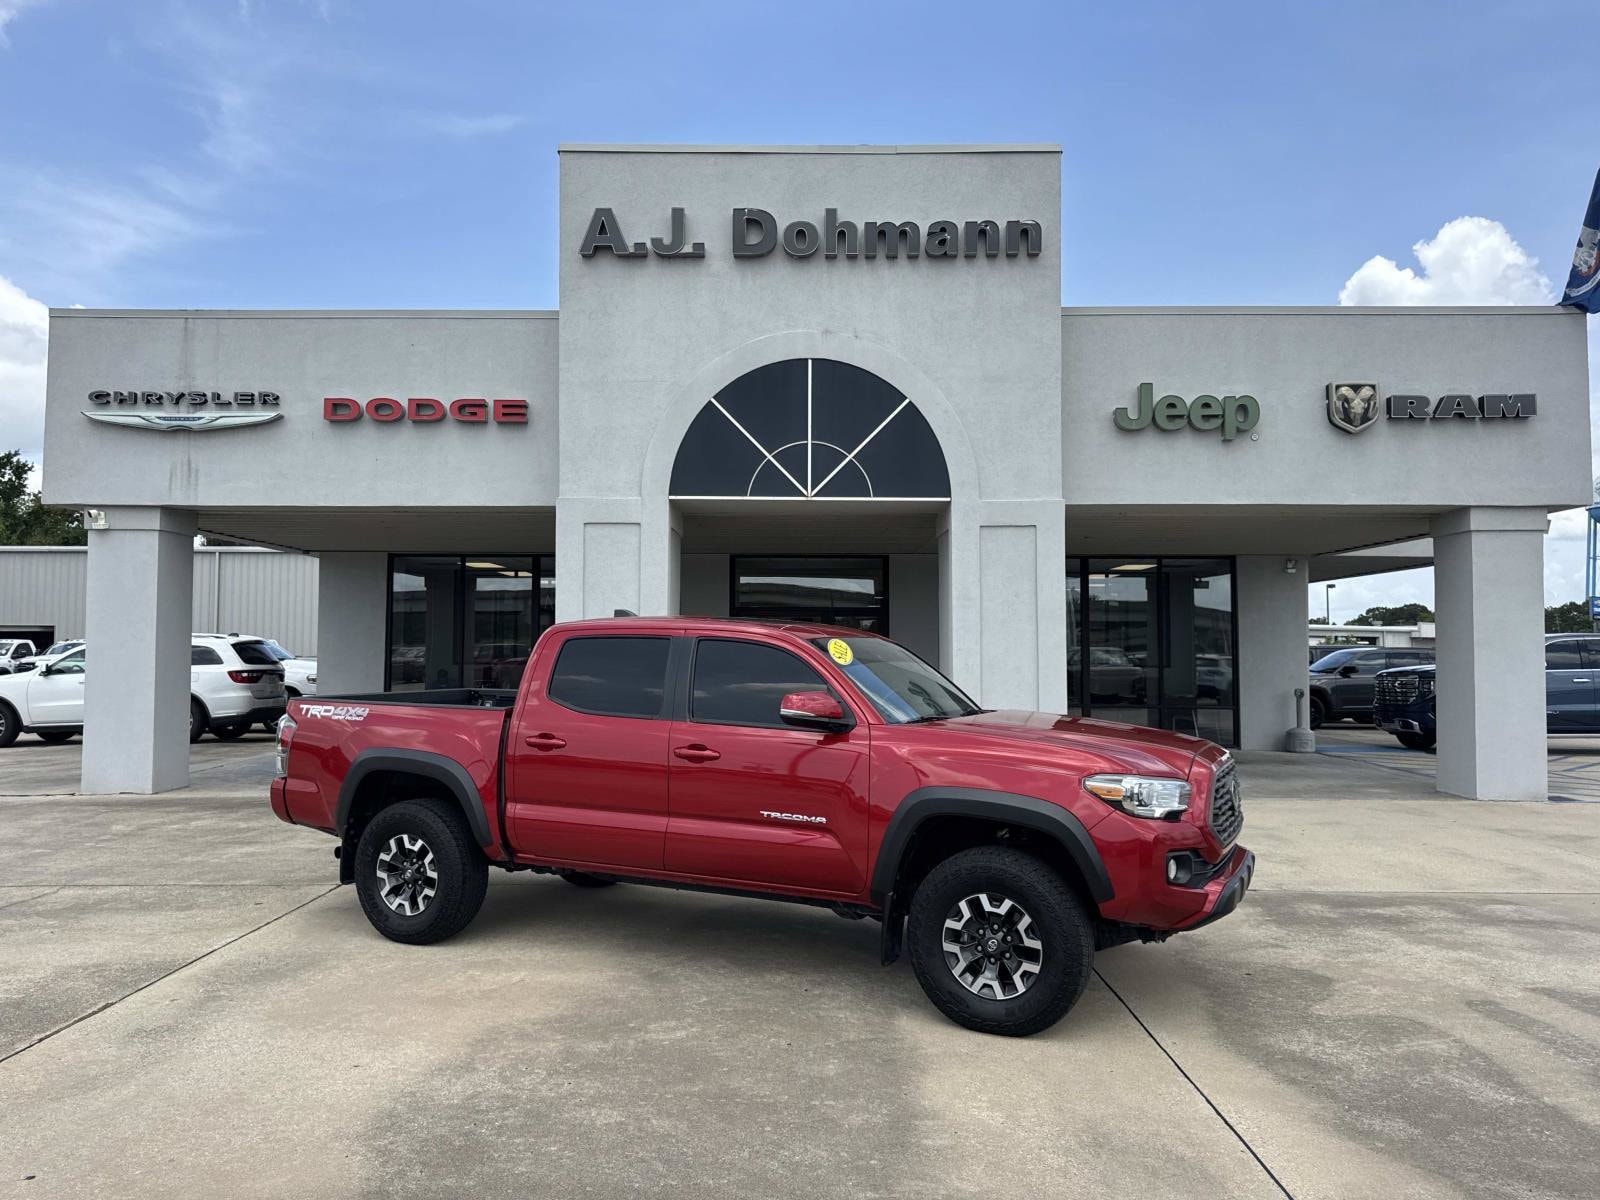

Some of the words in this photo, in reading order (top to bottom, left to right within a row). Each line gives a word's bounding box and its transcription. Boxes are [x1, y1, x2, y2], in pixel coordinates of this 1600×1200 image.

[579, 207, 706, 258] A.J.
[732, 207, 1043, 259] Dohmann
[87, 390, 281, 406] CHRYSLER
[323, 397, 529, 424] DODGE
[1386, 394, 1538, 420] RAM
[1113, 382, 1261, 441] Jeep
[300, 704, 335, 719] TRD
[759, 810, 827, 824] TACOMA
